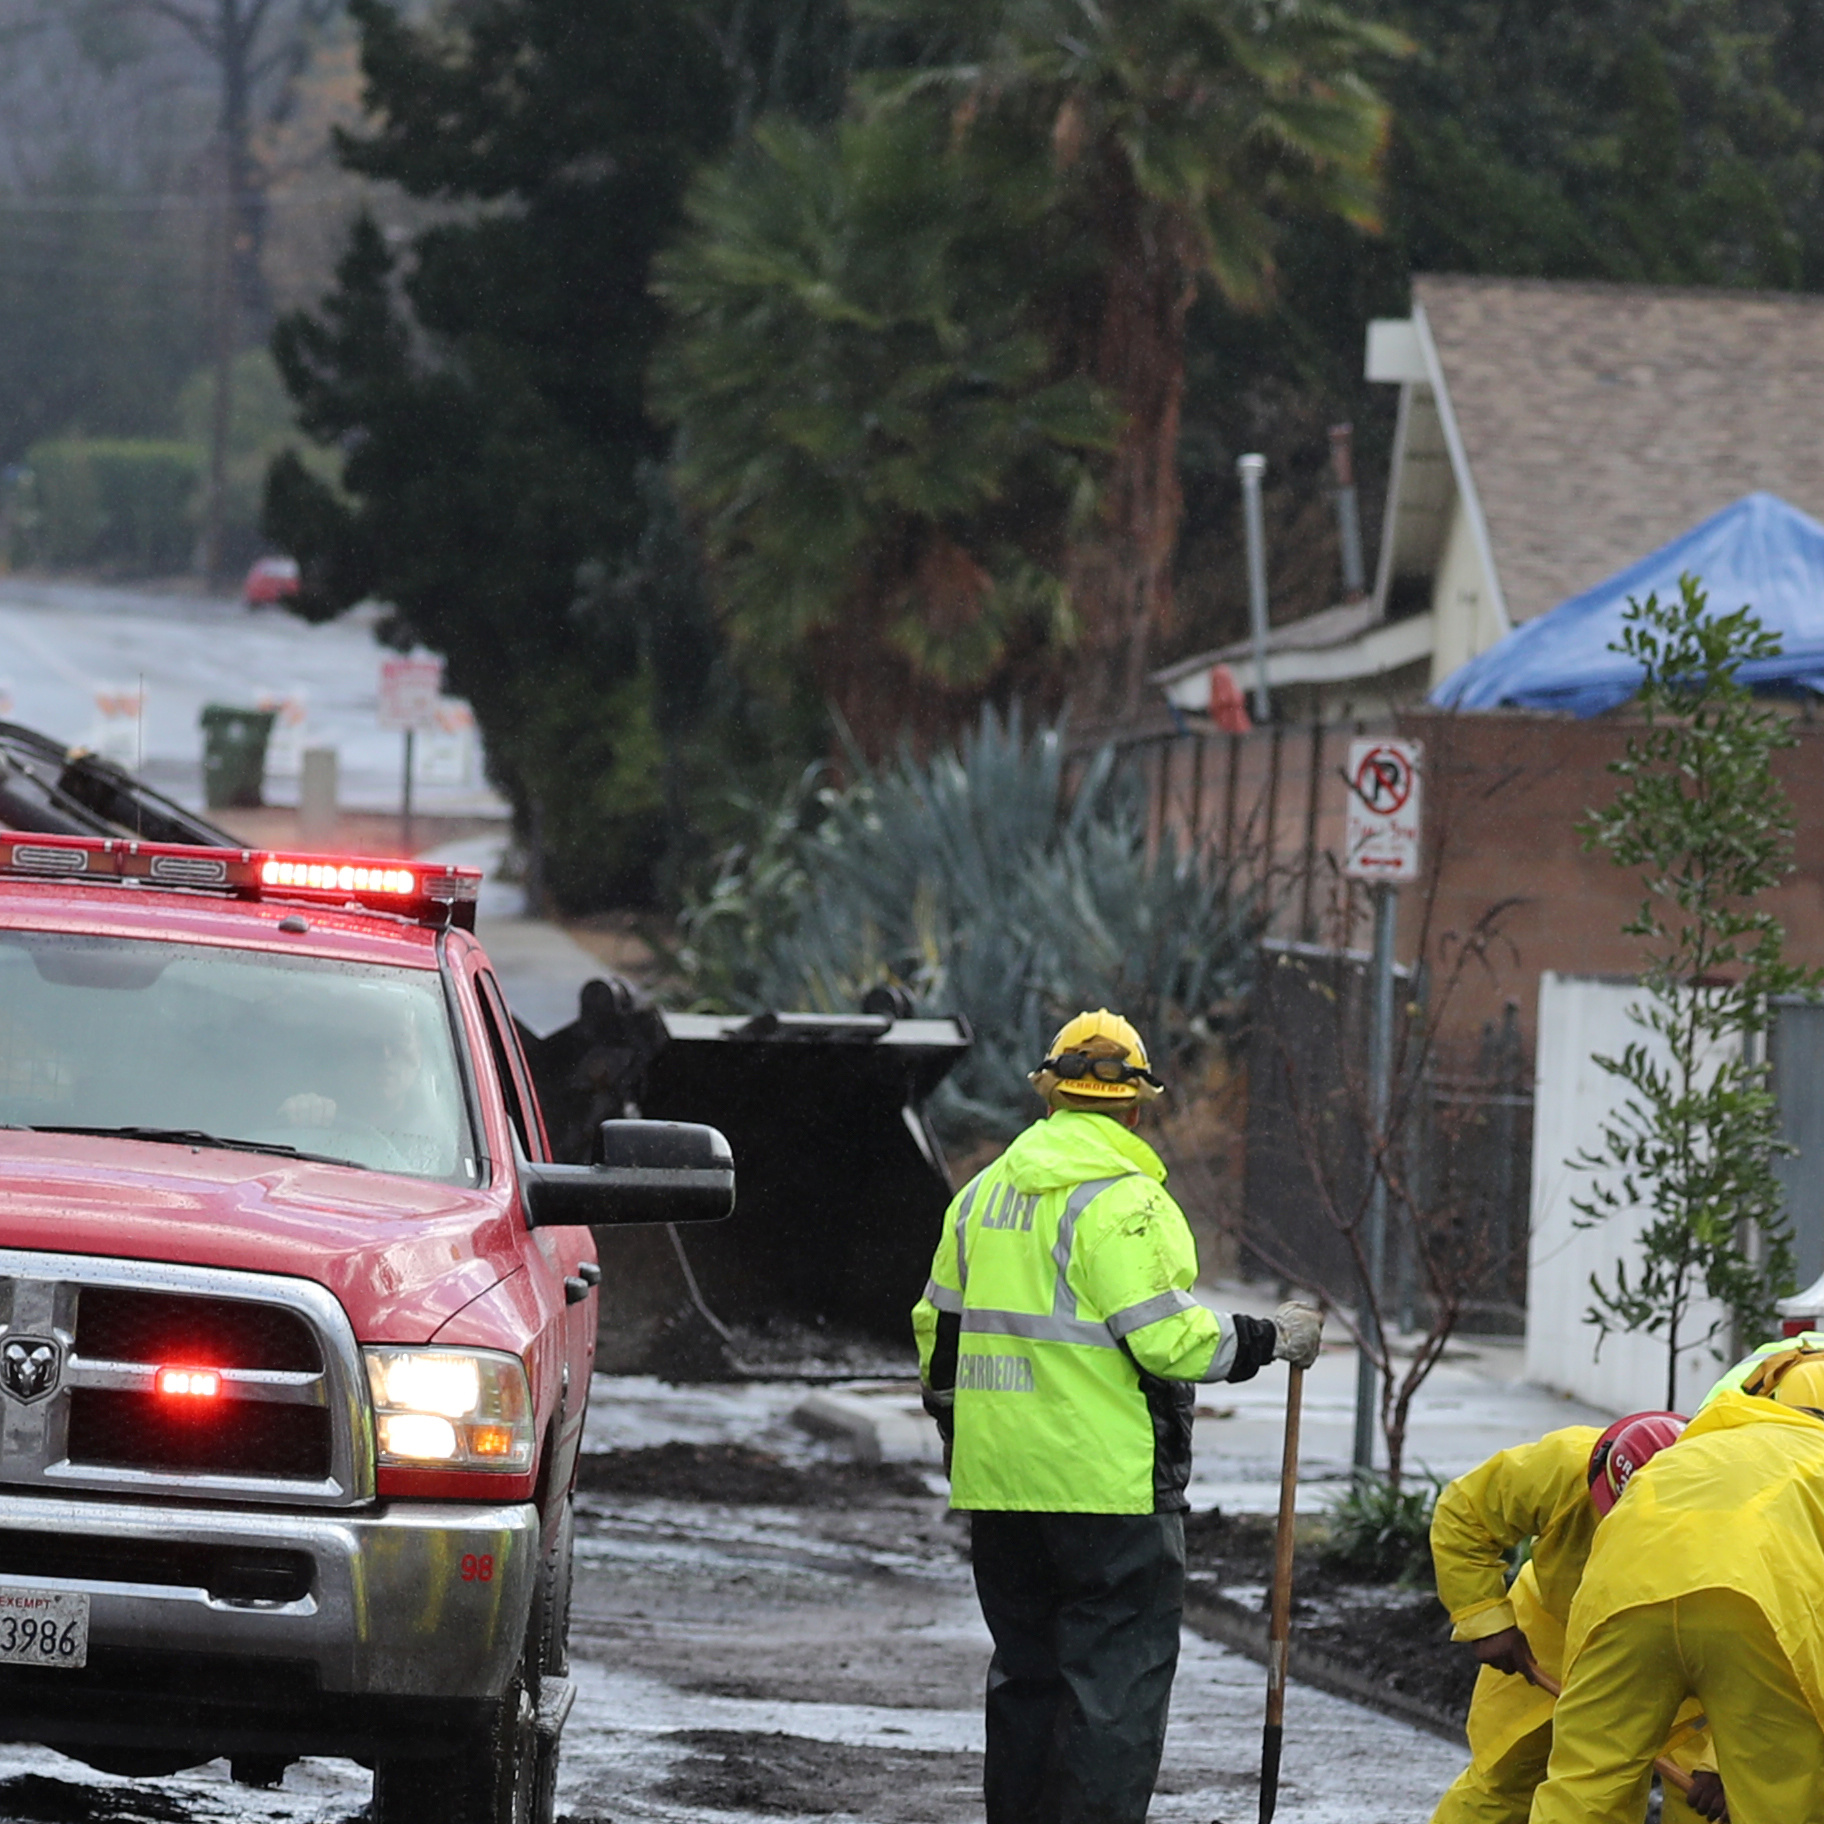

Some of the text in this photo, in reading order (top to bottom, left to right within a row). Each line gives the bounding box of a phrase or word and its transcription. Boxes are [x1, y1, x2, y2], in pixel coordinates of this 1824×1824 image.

[958, 1353, 1034, 1393] CHROEDER
[1616, 1454, 1634, 1475] CR
[461, 1553, 494, 1582] 98
